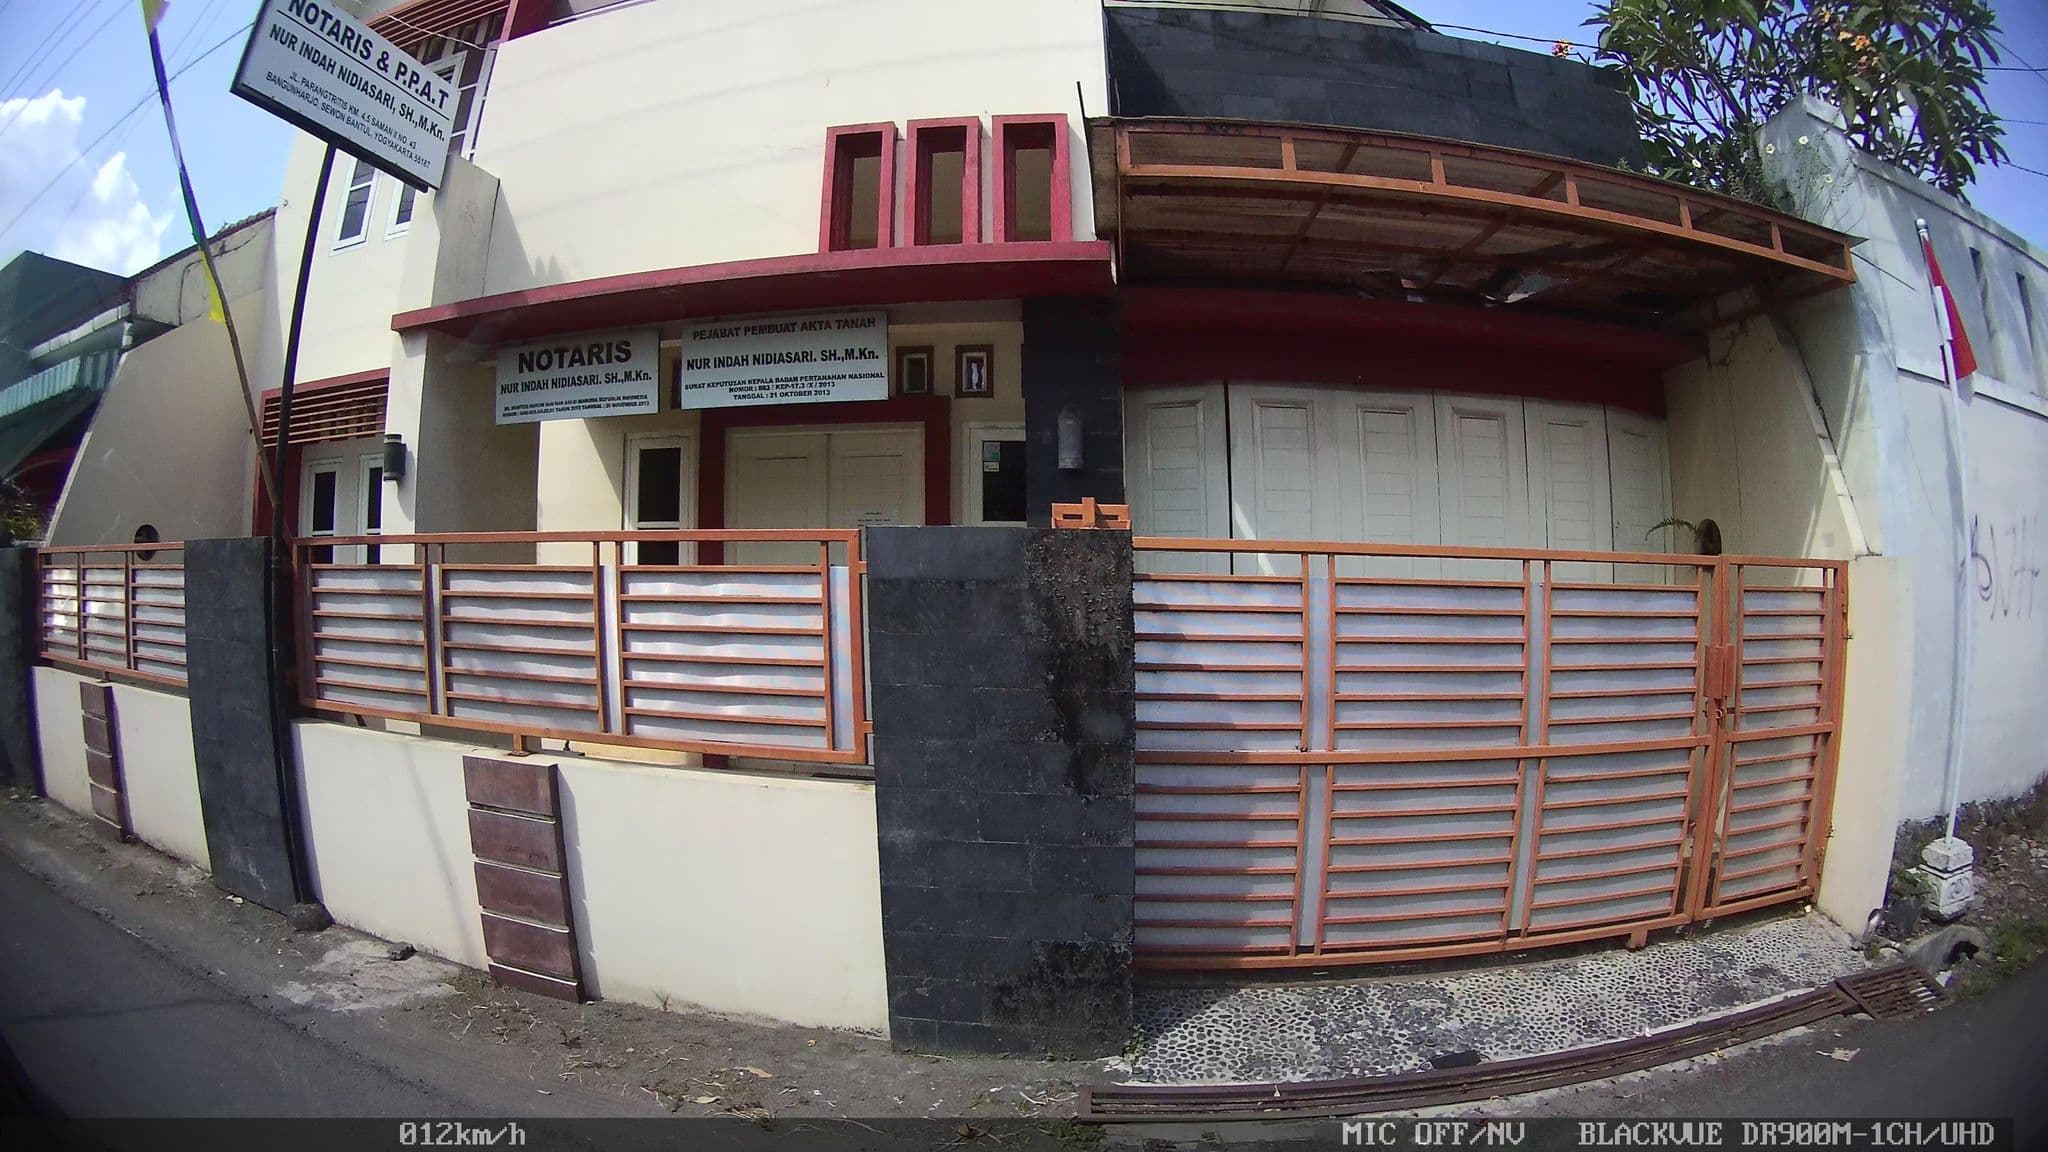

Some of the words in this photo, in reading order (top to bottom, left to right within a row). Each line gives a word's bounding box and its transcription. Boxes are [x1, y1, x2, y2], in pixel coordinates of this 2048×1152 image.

[288, 0, 373, 60] NOTARIS
[376, 51, 389, 73] &
[395, 61, 450, 109] P.P.A.T
[269, 24, 298, 51] NUR
[299, 41, 337, 75] INDAH
[338, 65, 396, 115] NIDIASARI,
[321, 102, 345, 122] SEWON
[374, 133, 413, 160] YOGYAKARTA
[693, 327, 740, 341] PEJABAT
[744, 322, 797, 336] PEMBUAT
[800, 319, 832, 332] AKTA
[835, 317, 876, 330] TANAH
[518, 340, 632, 374] NOTARIS
[686, 357, 710, 371] NUR
[713, 354, 749, 369] INDAH
[500, 381, 519, 395] NUR
[521, 378, 549, 392] INDAH
[685, 382, 706, 390] SURAT
[707, 379, 746, 389] KEPUTUSAN
[748, 377, 773, 385] KEPALA
[775, 375, 798, 384] BADAN
[800, 373, 847, 382] PERTANAHAN
[848, 371, 885, 380] NASIONAL
[729, 385, 753, 393] NOMOR
[818, 380, 835, 388] 2013
[733, 391, 764, 400] TANGGAL
[779, 389, 812, 398] OKTOBER
[814, 388, 831, 396] 2013
